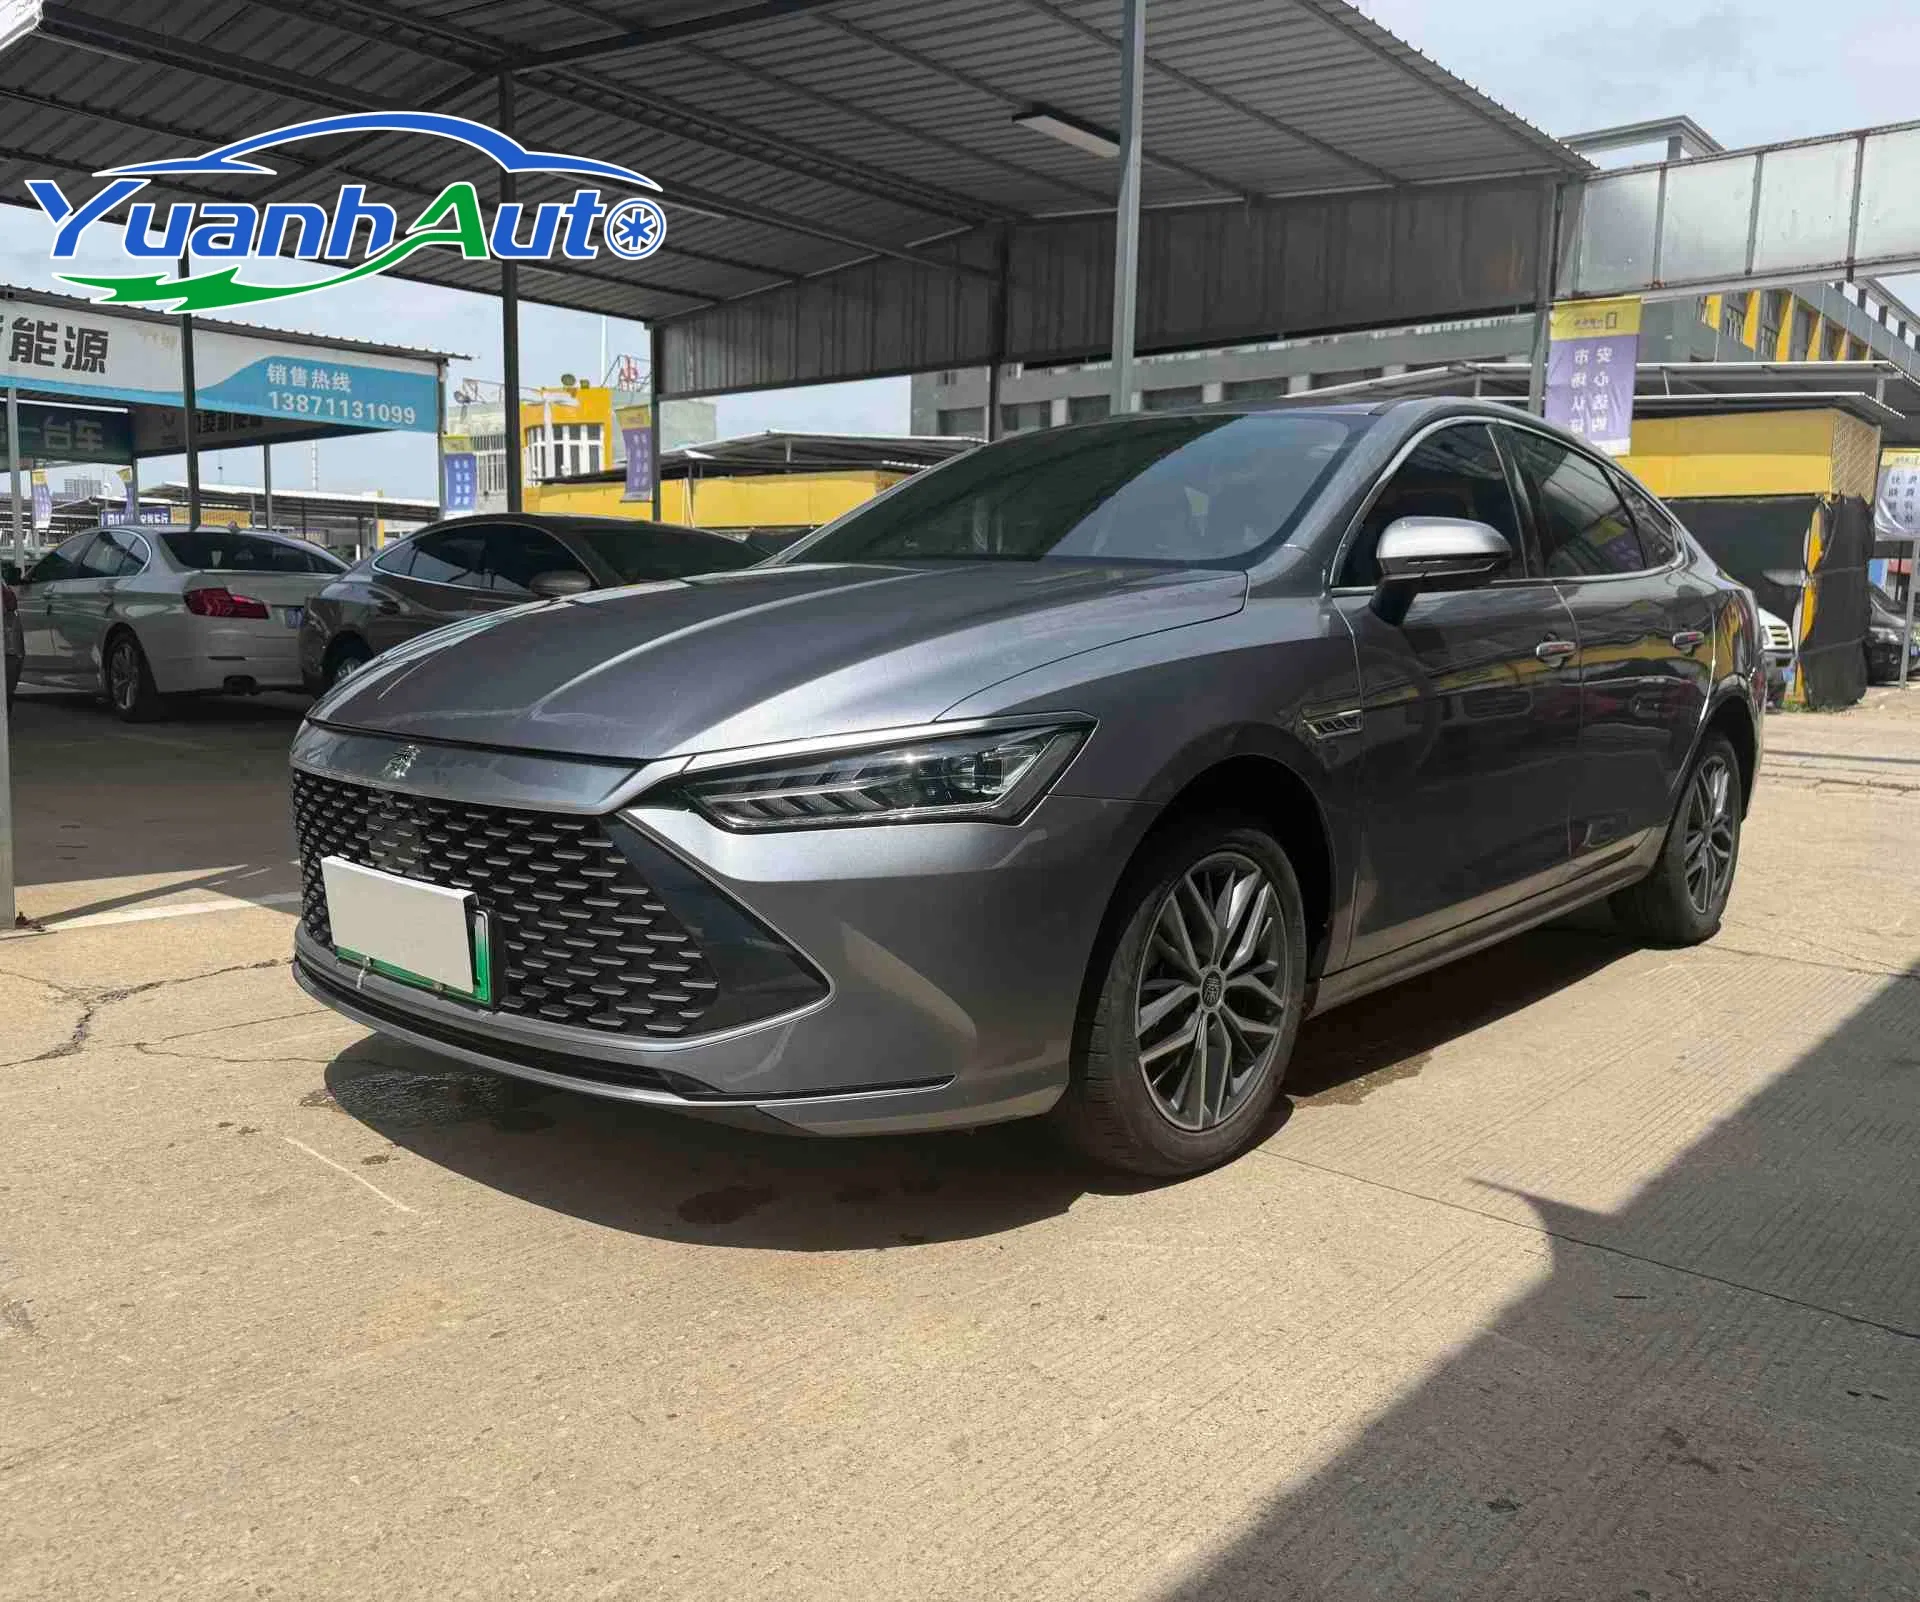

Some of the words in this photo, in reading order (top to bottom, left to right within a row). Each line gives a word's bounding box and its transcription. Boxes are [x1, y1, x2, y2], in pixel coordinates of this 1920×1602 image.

[0, 315, 109, 374] 能源
[266, 363, 352, 393] 销售热线
[269, 391, 416, 425] 13871131099
